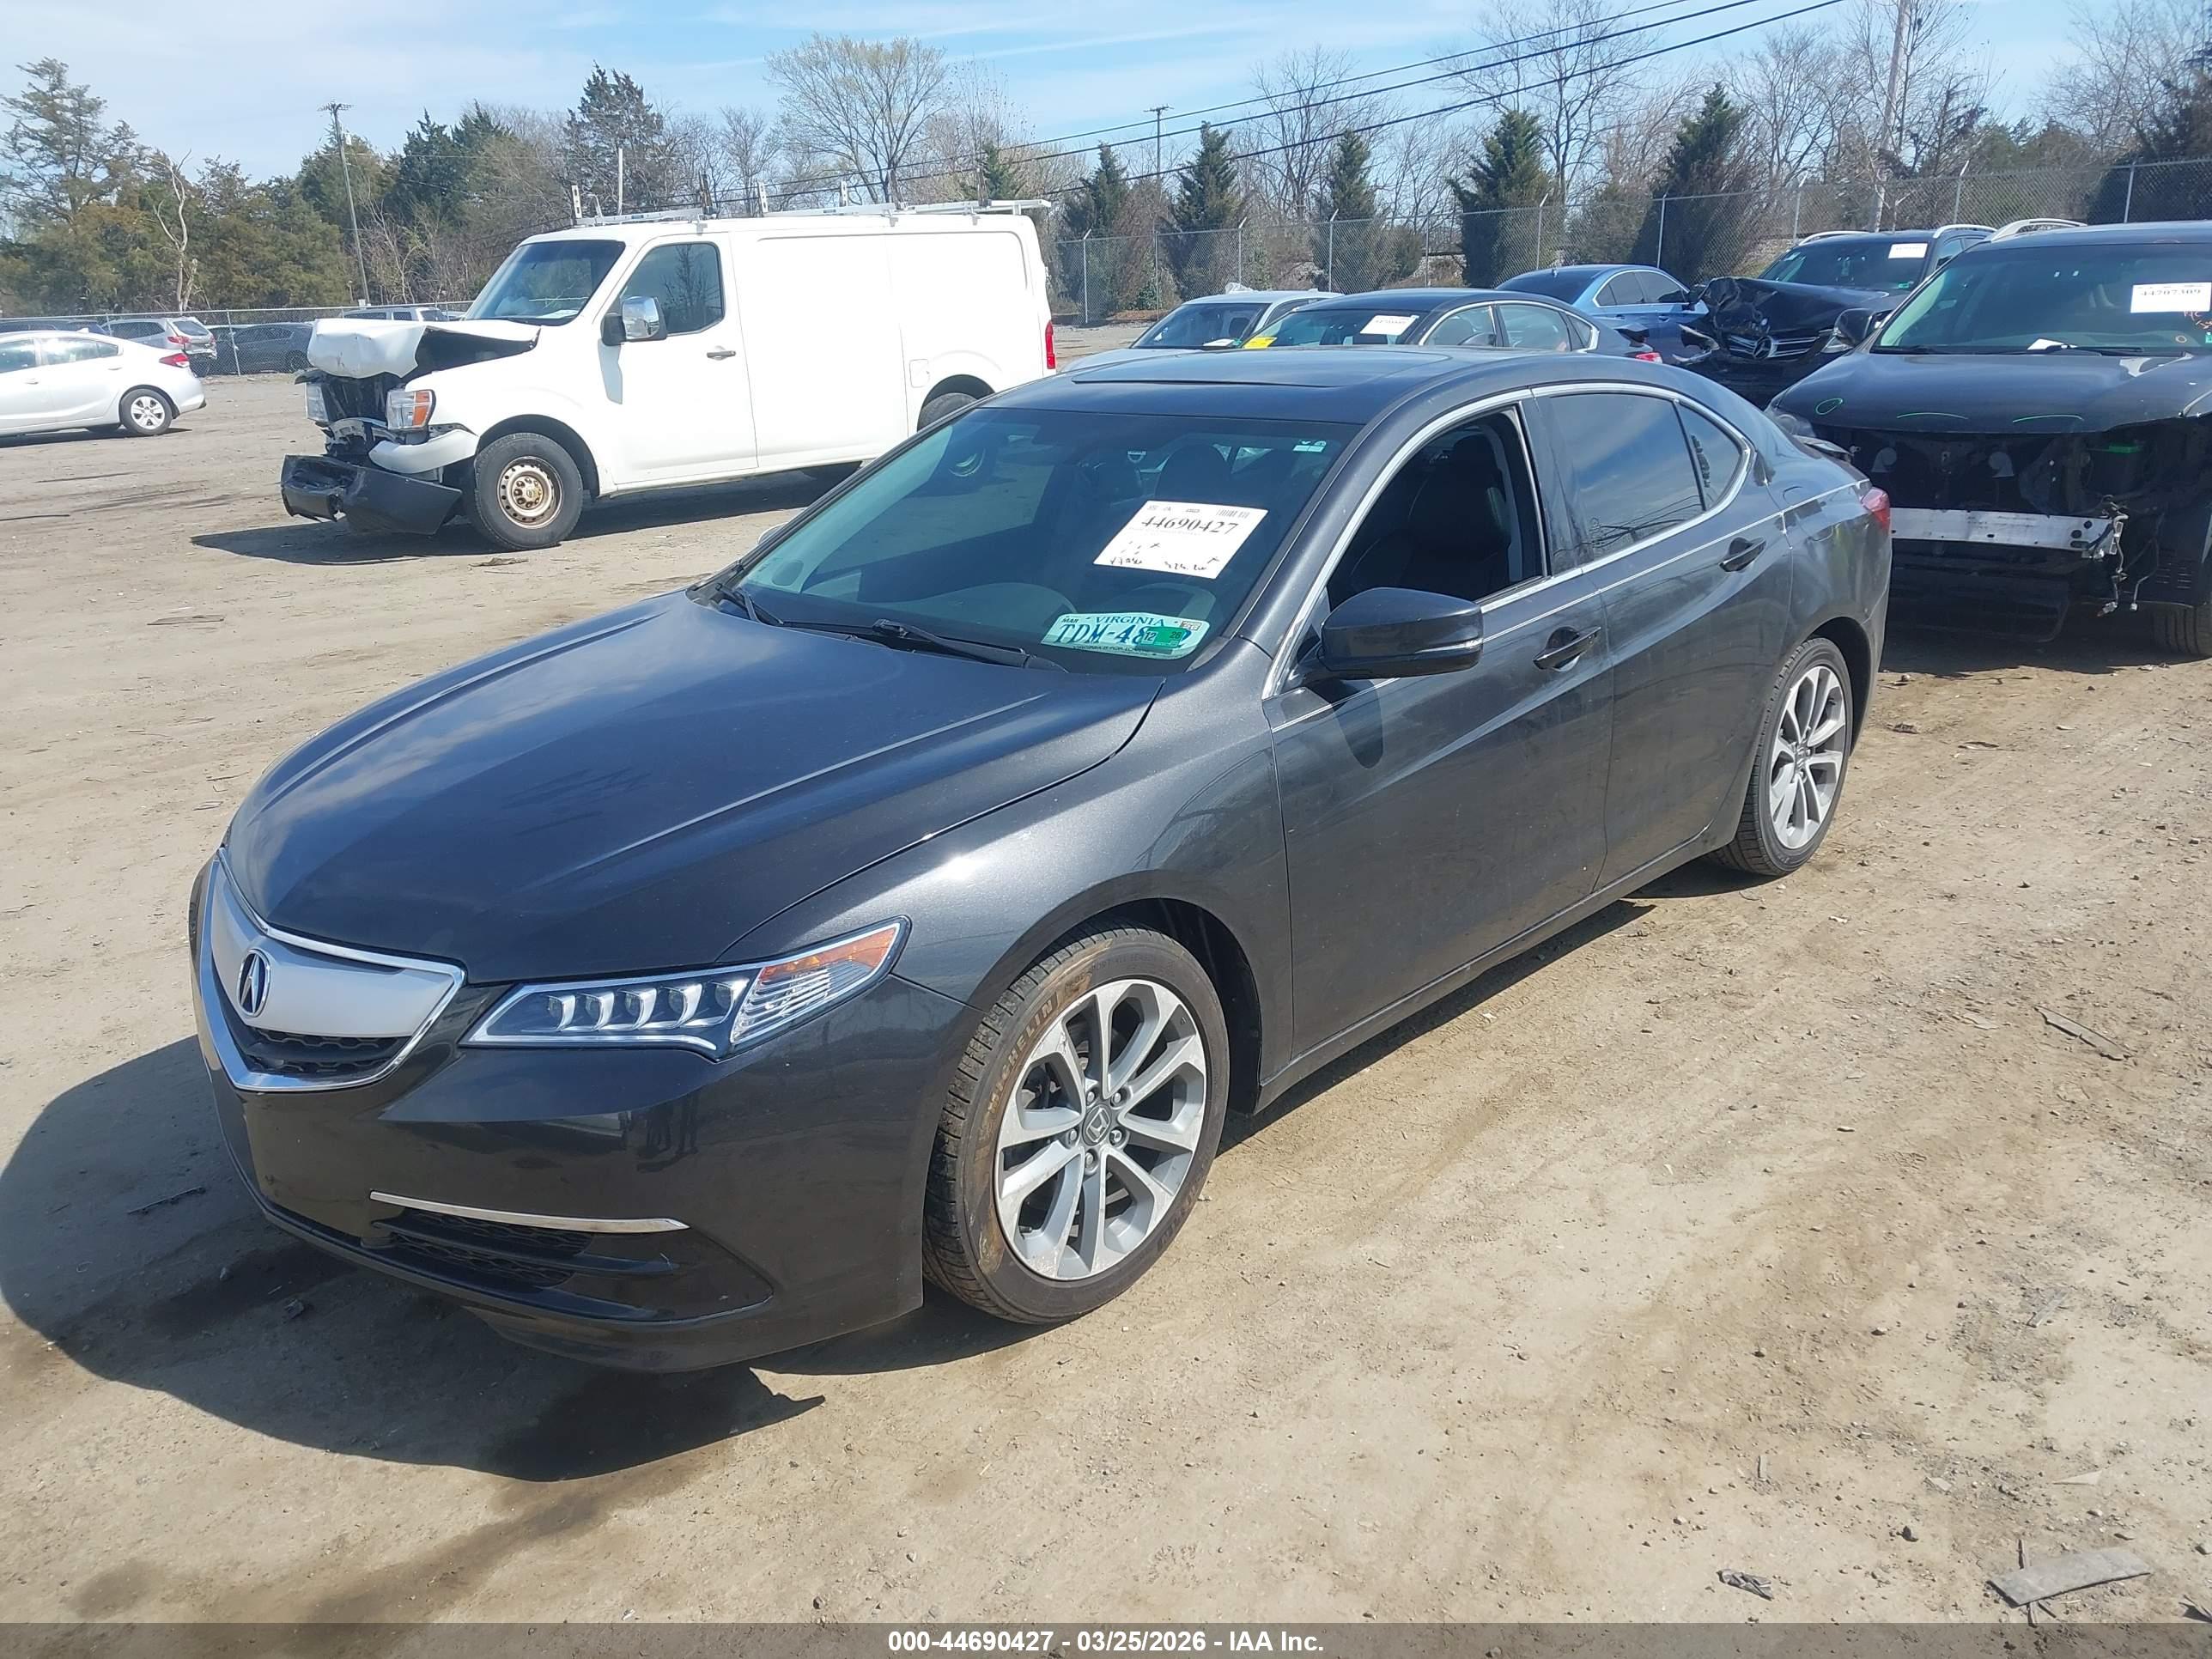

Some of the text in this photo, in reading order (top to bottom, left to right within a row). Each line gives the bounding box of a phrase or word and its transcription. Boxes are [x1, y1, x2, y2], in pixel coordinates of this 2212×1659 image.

[1141, 515, 1239, 535] 44690427
[1095, 617, 1165, 627] VIRGINIA
[1144, 632, 1157, 641] 12
